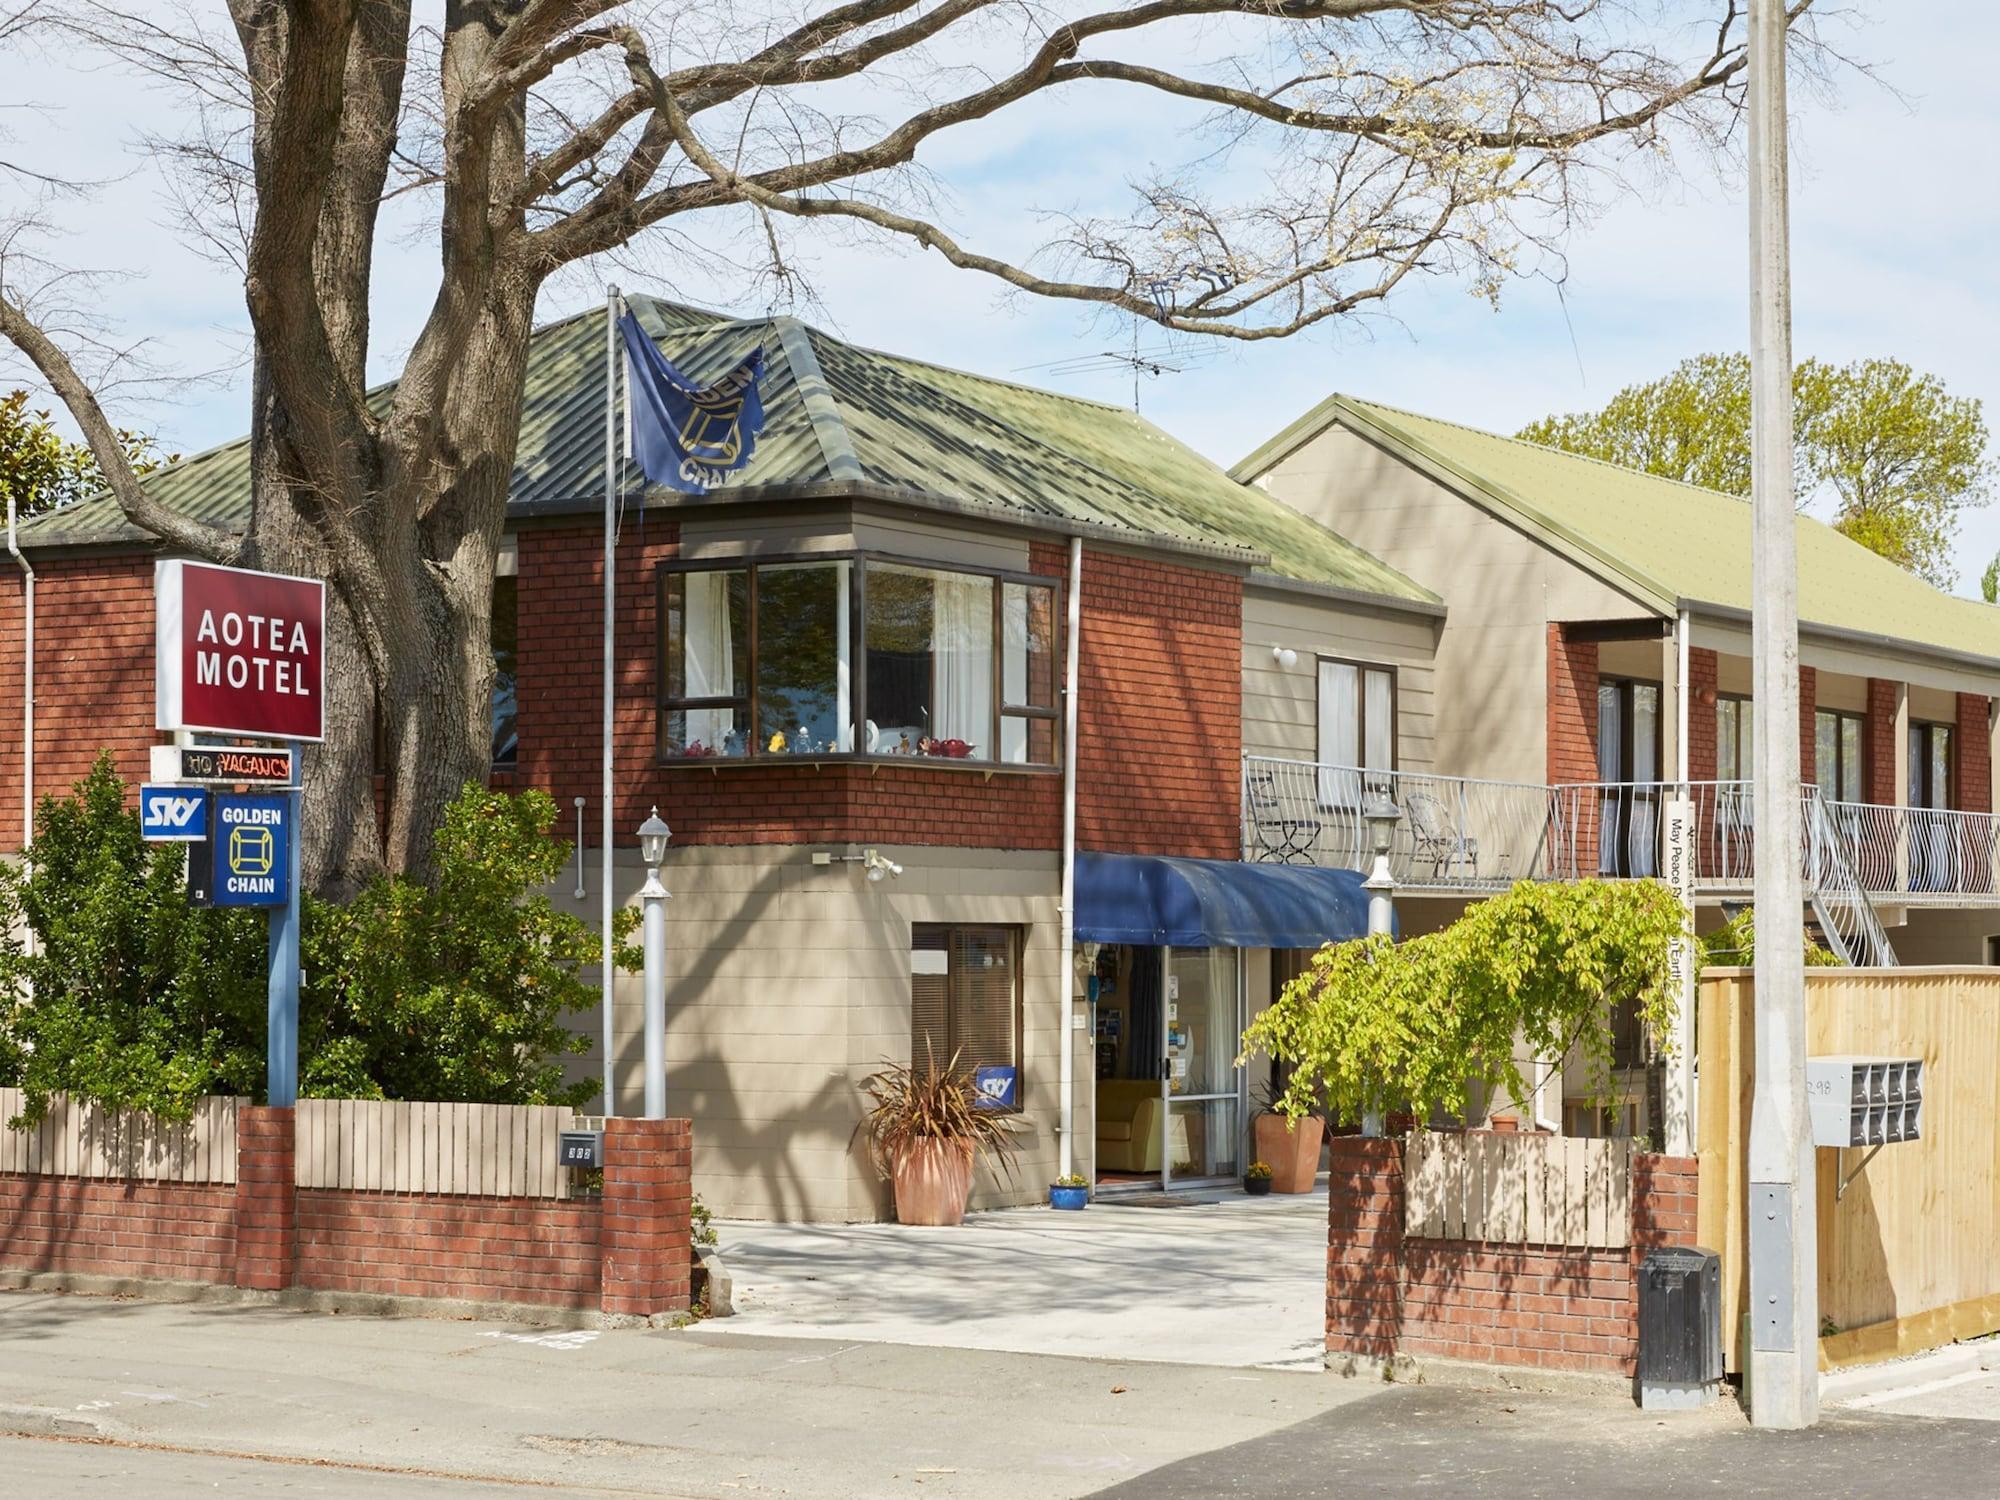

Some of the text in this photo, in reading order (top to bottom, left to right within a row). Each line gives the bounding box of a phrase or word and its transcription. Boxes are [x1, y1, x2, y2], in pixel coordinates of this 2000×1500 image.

[197, 610, 309, 655] AOTEA
[197, 650, 310, 696] MOTEL
[187, 754, 289, 776] NO VACANCY
[144, 796, 203, 827] SKY
[222, 806, 281, 825] GOLDEN
[1669, 819, 1682, 843] May
[1671, 847, 1682, 884] Peace
[227, 877, 275, 894] CHAIN
